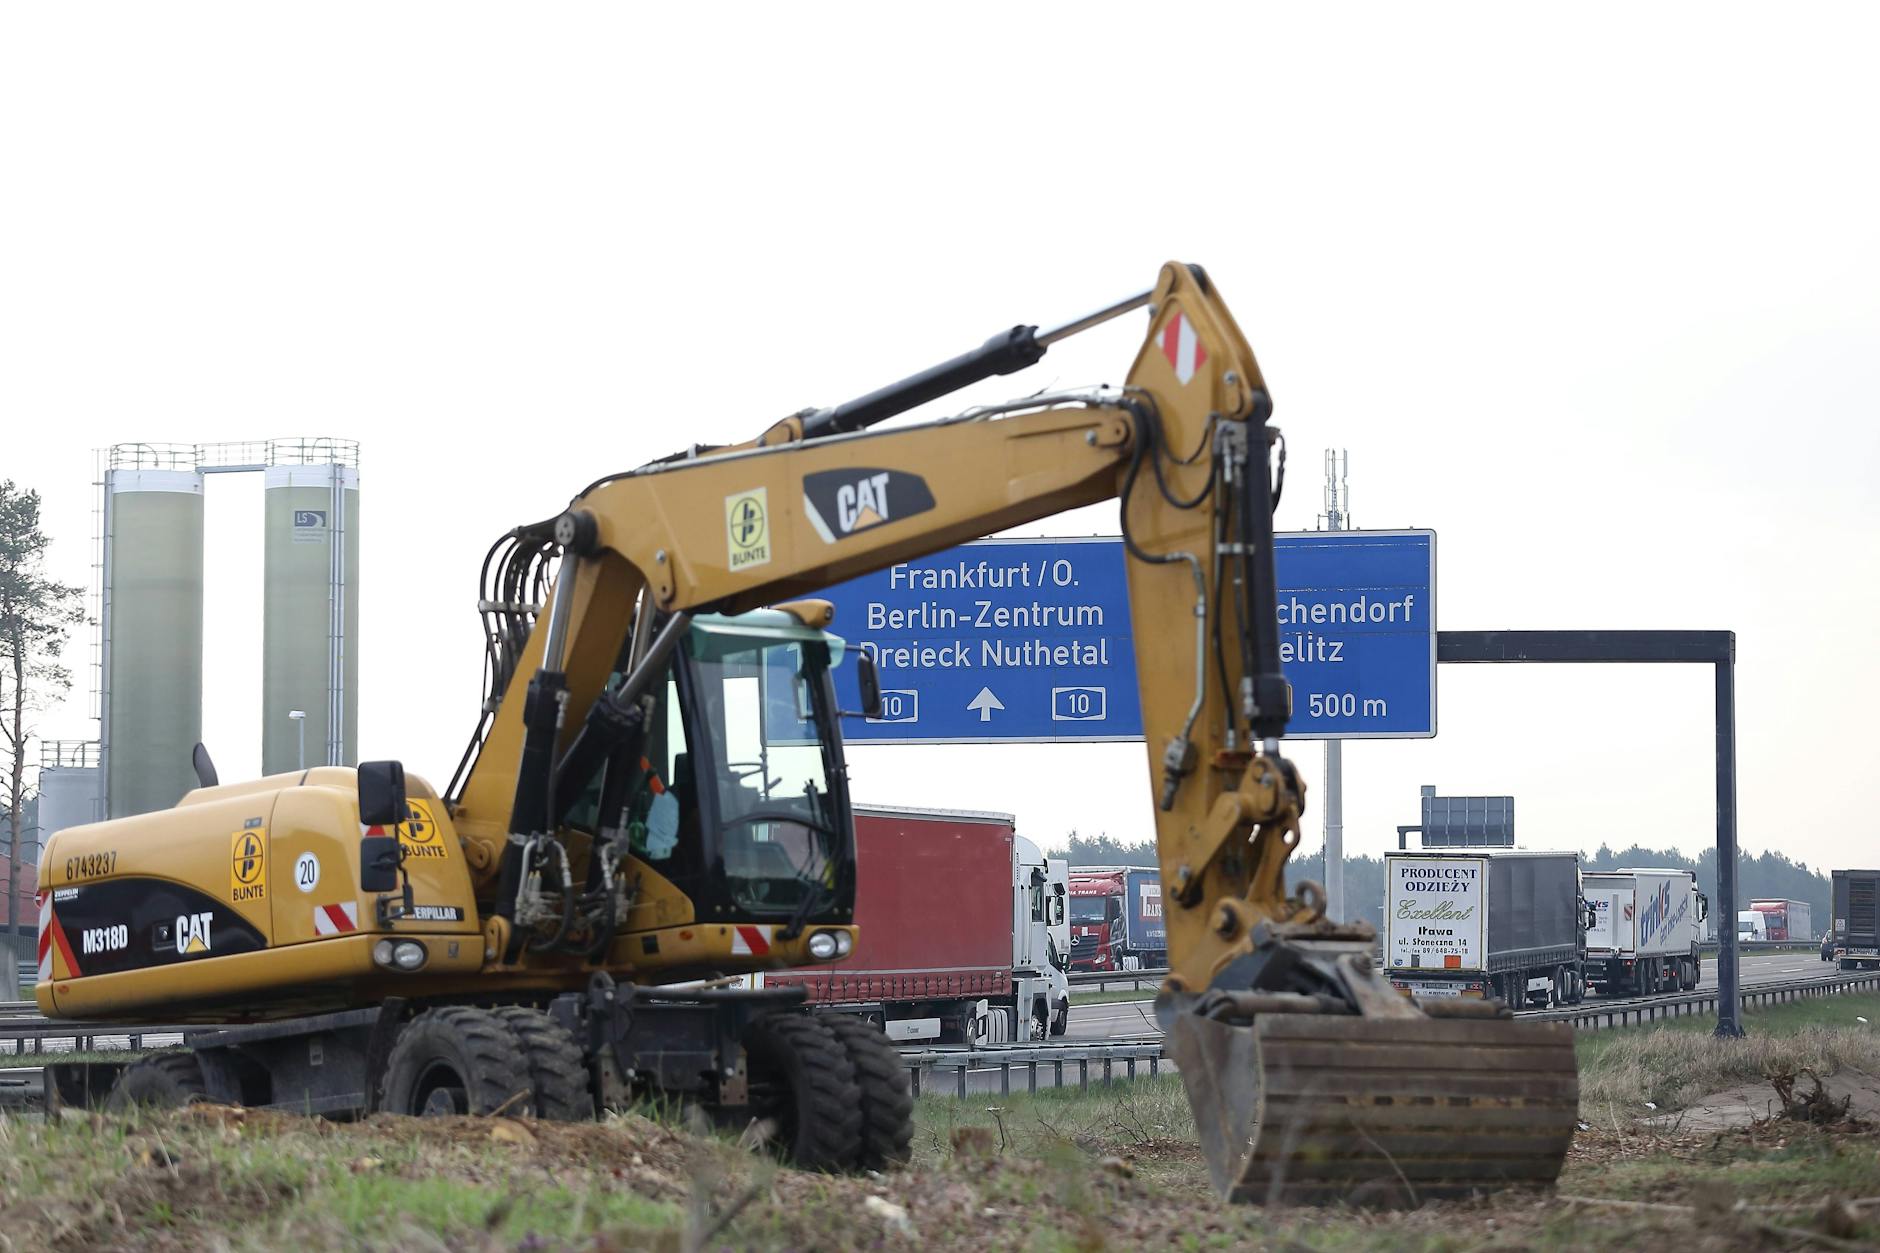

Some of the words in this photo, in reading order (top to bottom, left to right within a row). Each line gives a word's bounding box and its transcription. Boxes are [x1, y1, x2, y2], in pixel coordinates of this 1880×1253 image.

[837, 472, 890, 533] CAT
[732, 547, 766, 567] BUNTE
[890, 562, 1030, 590] Frankfurt
[867, 601, 1104, 630] Berlin-Zentrum
[1275, 594, 1414, 624] chendorf
[860, 640, 971, 668] Dreieck
[982, 638, 1109, 667] Nuthetal
[1278, 634, 1344, 662] elitz
[881, 696, 902, 717] 10
[1068, 694, 1090, 714] 10
[1309, 693, 1356, 717] 500
[1363, 699, 1387, 717] m
[66, 851, 117, 880] 6743237
[300, 859, 315, 885] 20
[1401, 868, 1477, 879] PRODUCENT
[233, 884, 264, 901] BUNTE
[1405, 880, 1470, 892] ODZIEŻY
[400, 906, 457, 920] ERPILLAR
[83, 924, 129, 955] M318D
[176, 911, 213, 954] CAT
[1458, 938, 1467, 946] 14
